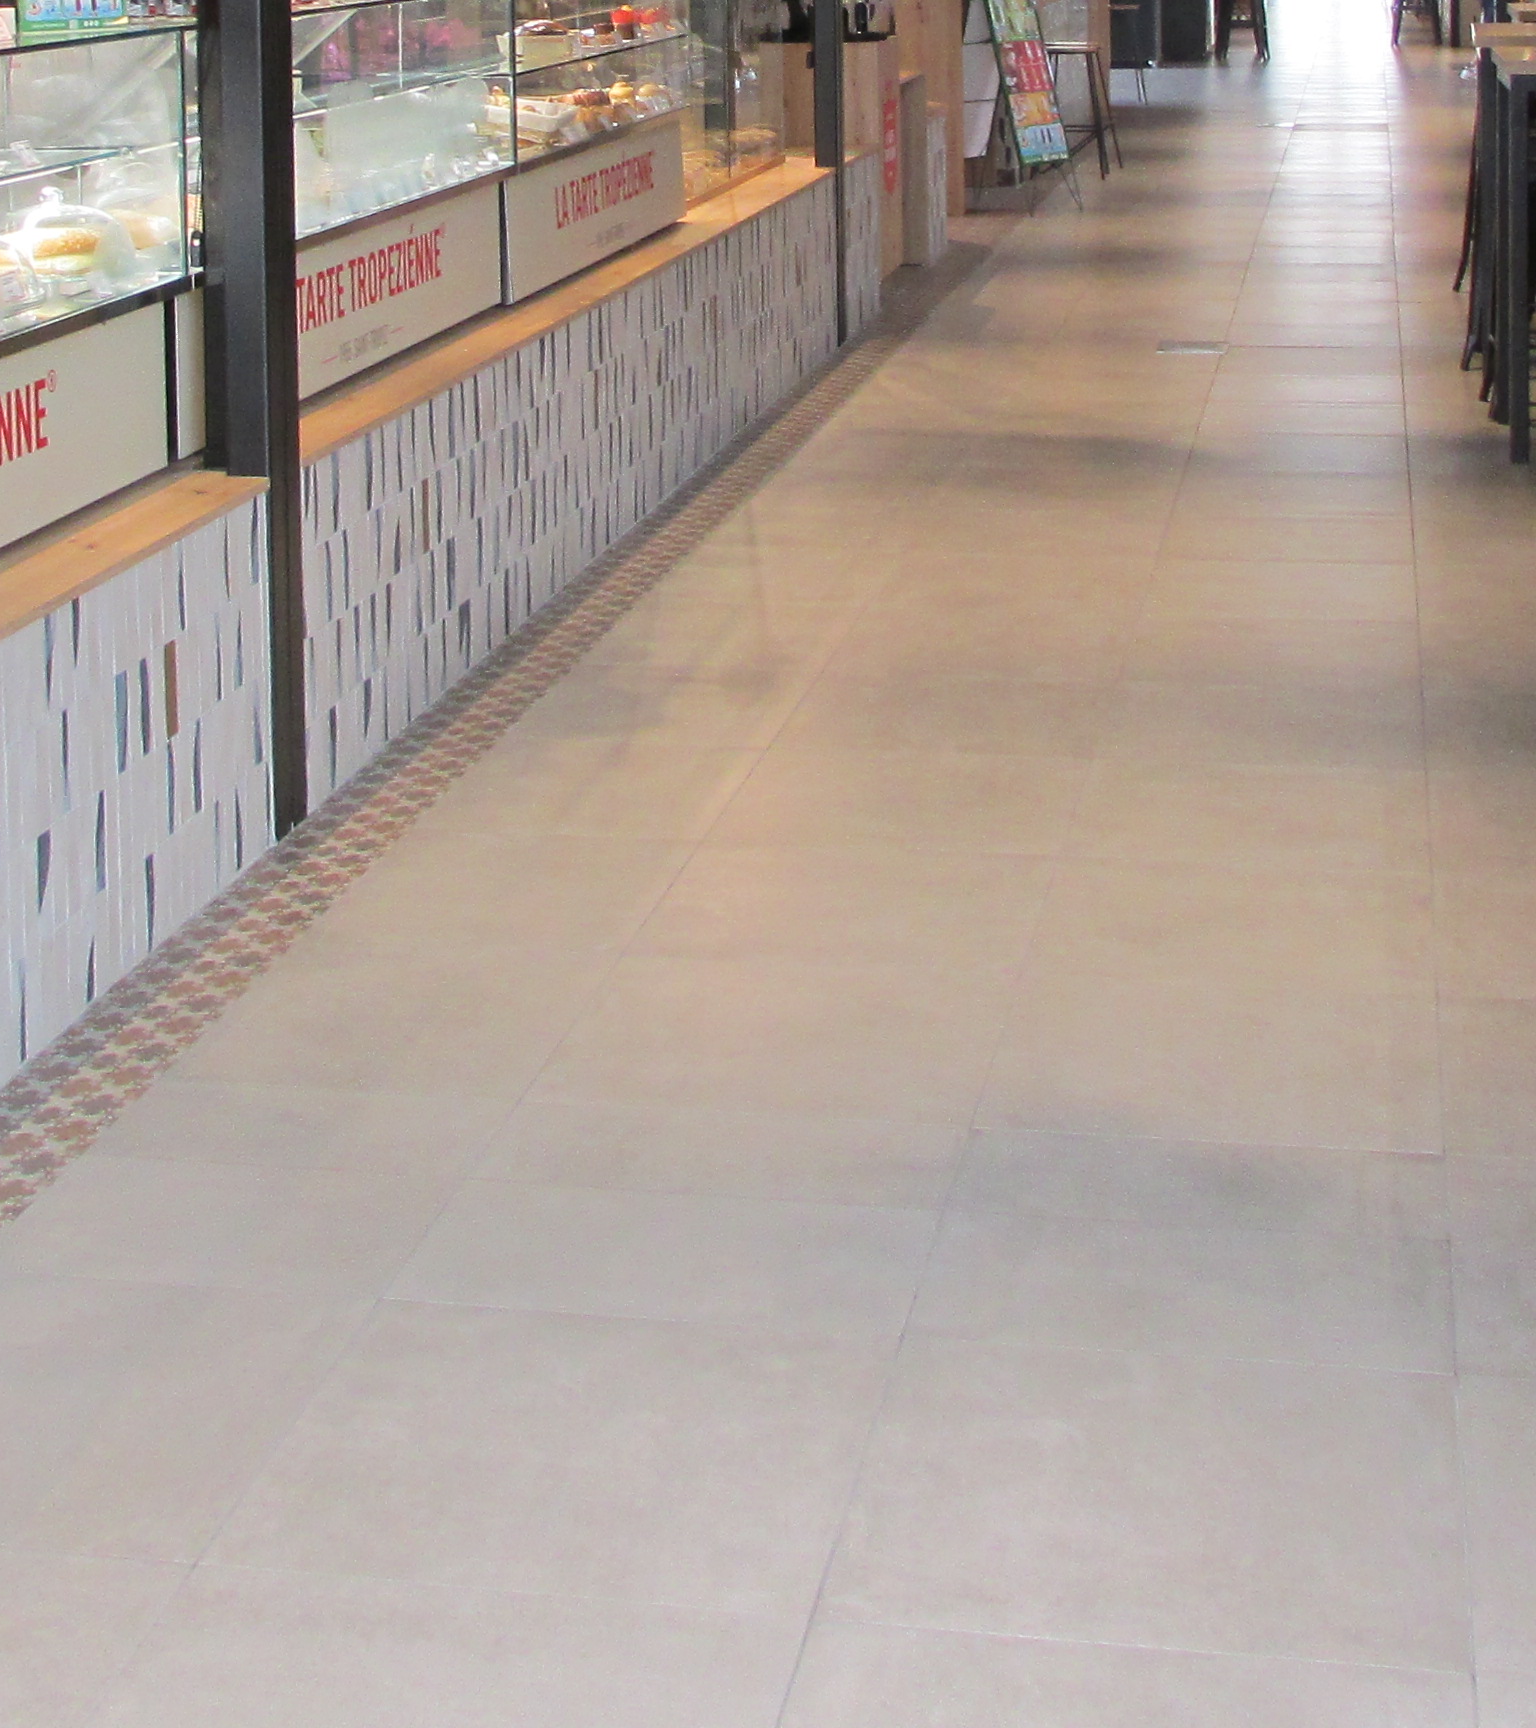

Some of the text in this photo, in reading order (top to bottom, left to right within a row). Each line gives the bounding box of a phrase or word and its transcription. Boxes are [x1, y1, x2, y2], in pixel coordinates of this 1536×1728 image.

[555, 184, 570, 229] LA
[570, 172, 598, 223] TARTE
[296, 264, 346, 334] TARTE
